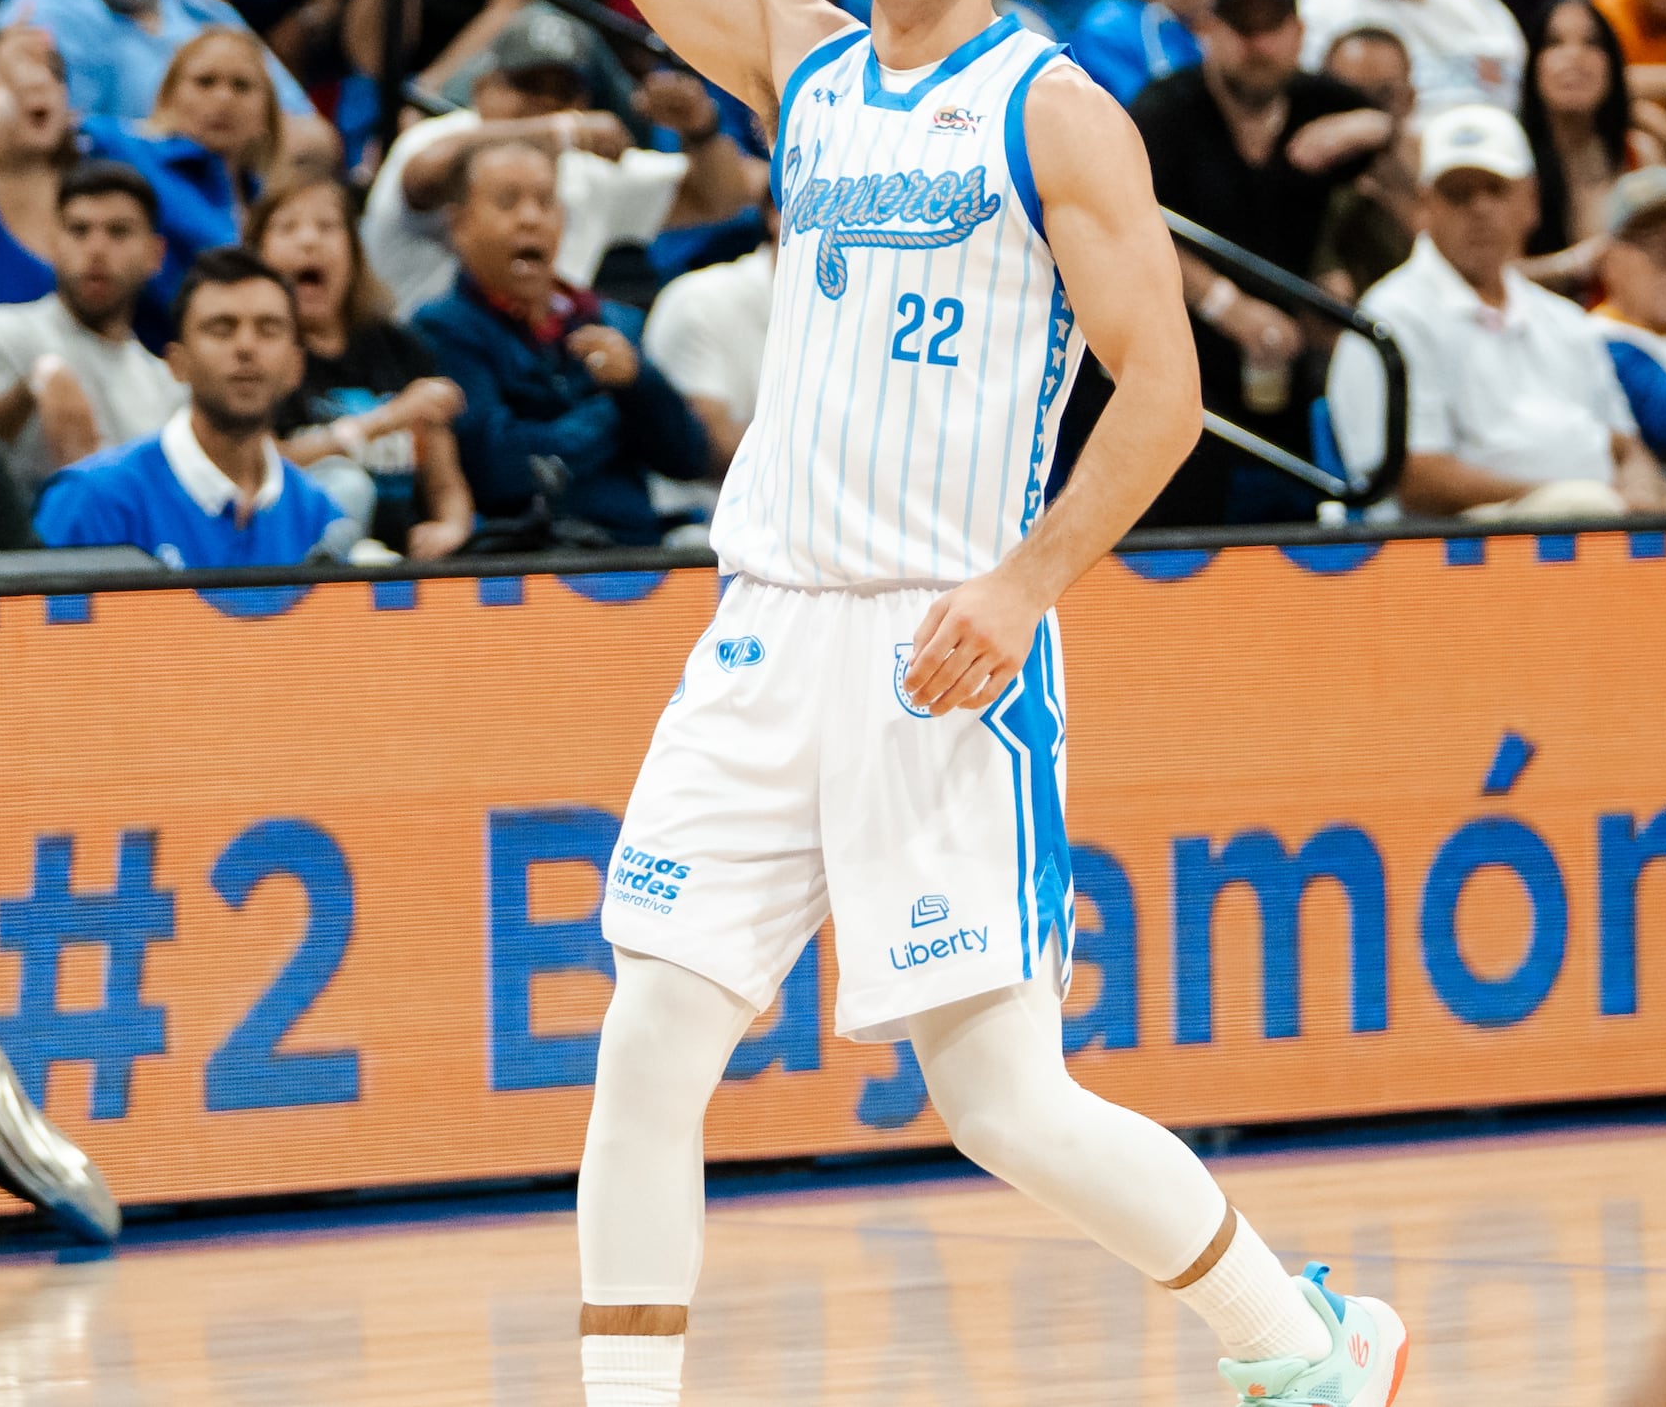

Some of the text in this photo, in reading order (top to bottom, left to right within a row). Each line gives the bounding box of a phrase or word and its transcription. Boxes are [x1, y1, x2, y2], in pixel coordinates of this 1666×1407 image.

[781, 139, 1001, 300] Vaqueros
[891, 292, 965, 367] 22
[620, 845, 692, 880] omas
[890, 924, 990, 971] Liberty
